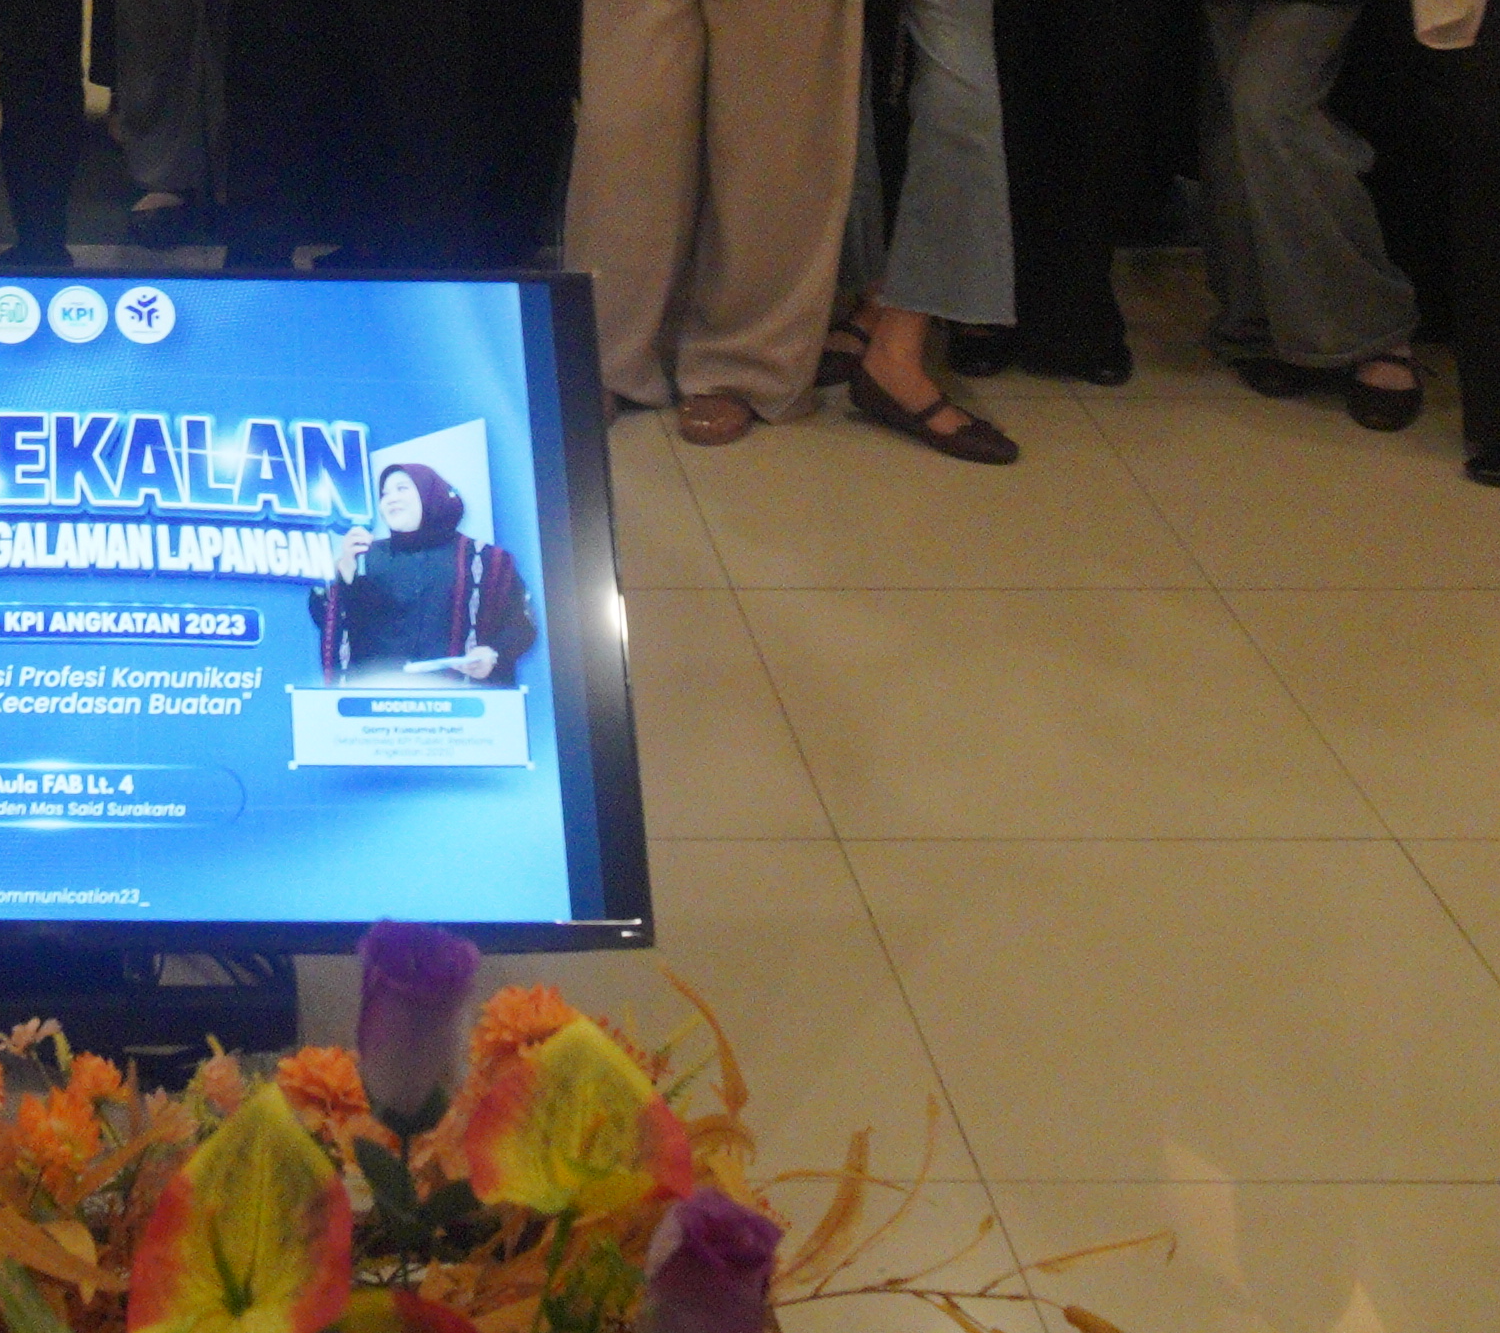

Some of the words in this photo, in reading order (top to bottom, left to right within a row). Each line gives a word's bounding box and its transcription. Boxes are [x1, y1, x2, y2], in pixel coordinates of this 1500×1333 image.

[61, 307, 94, 323] KPI
[156, 523, 337, 582] LAPANGAN
[4, 612, 44, 632] KPI
[49, 612, 181, 634] ANGKATAN
[185, 614, 246, 636] 2023
[19, 665, 105, 689] Profesi
[112, 667, 262, 690] Komunikasi
[148, 693, 252, 716] Buatan"
[371, 700, 452, 713] MODERATOR
[42, 774, 84, 795] FAB
[87, 775, 115, 795] Lt.
[118, 775, 135, 795] 4
[30, 803, 64, 817] Mas
[67, 802, 103, 817] Said
[107, 803, 186, 818] Surakarta
